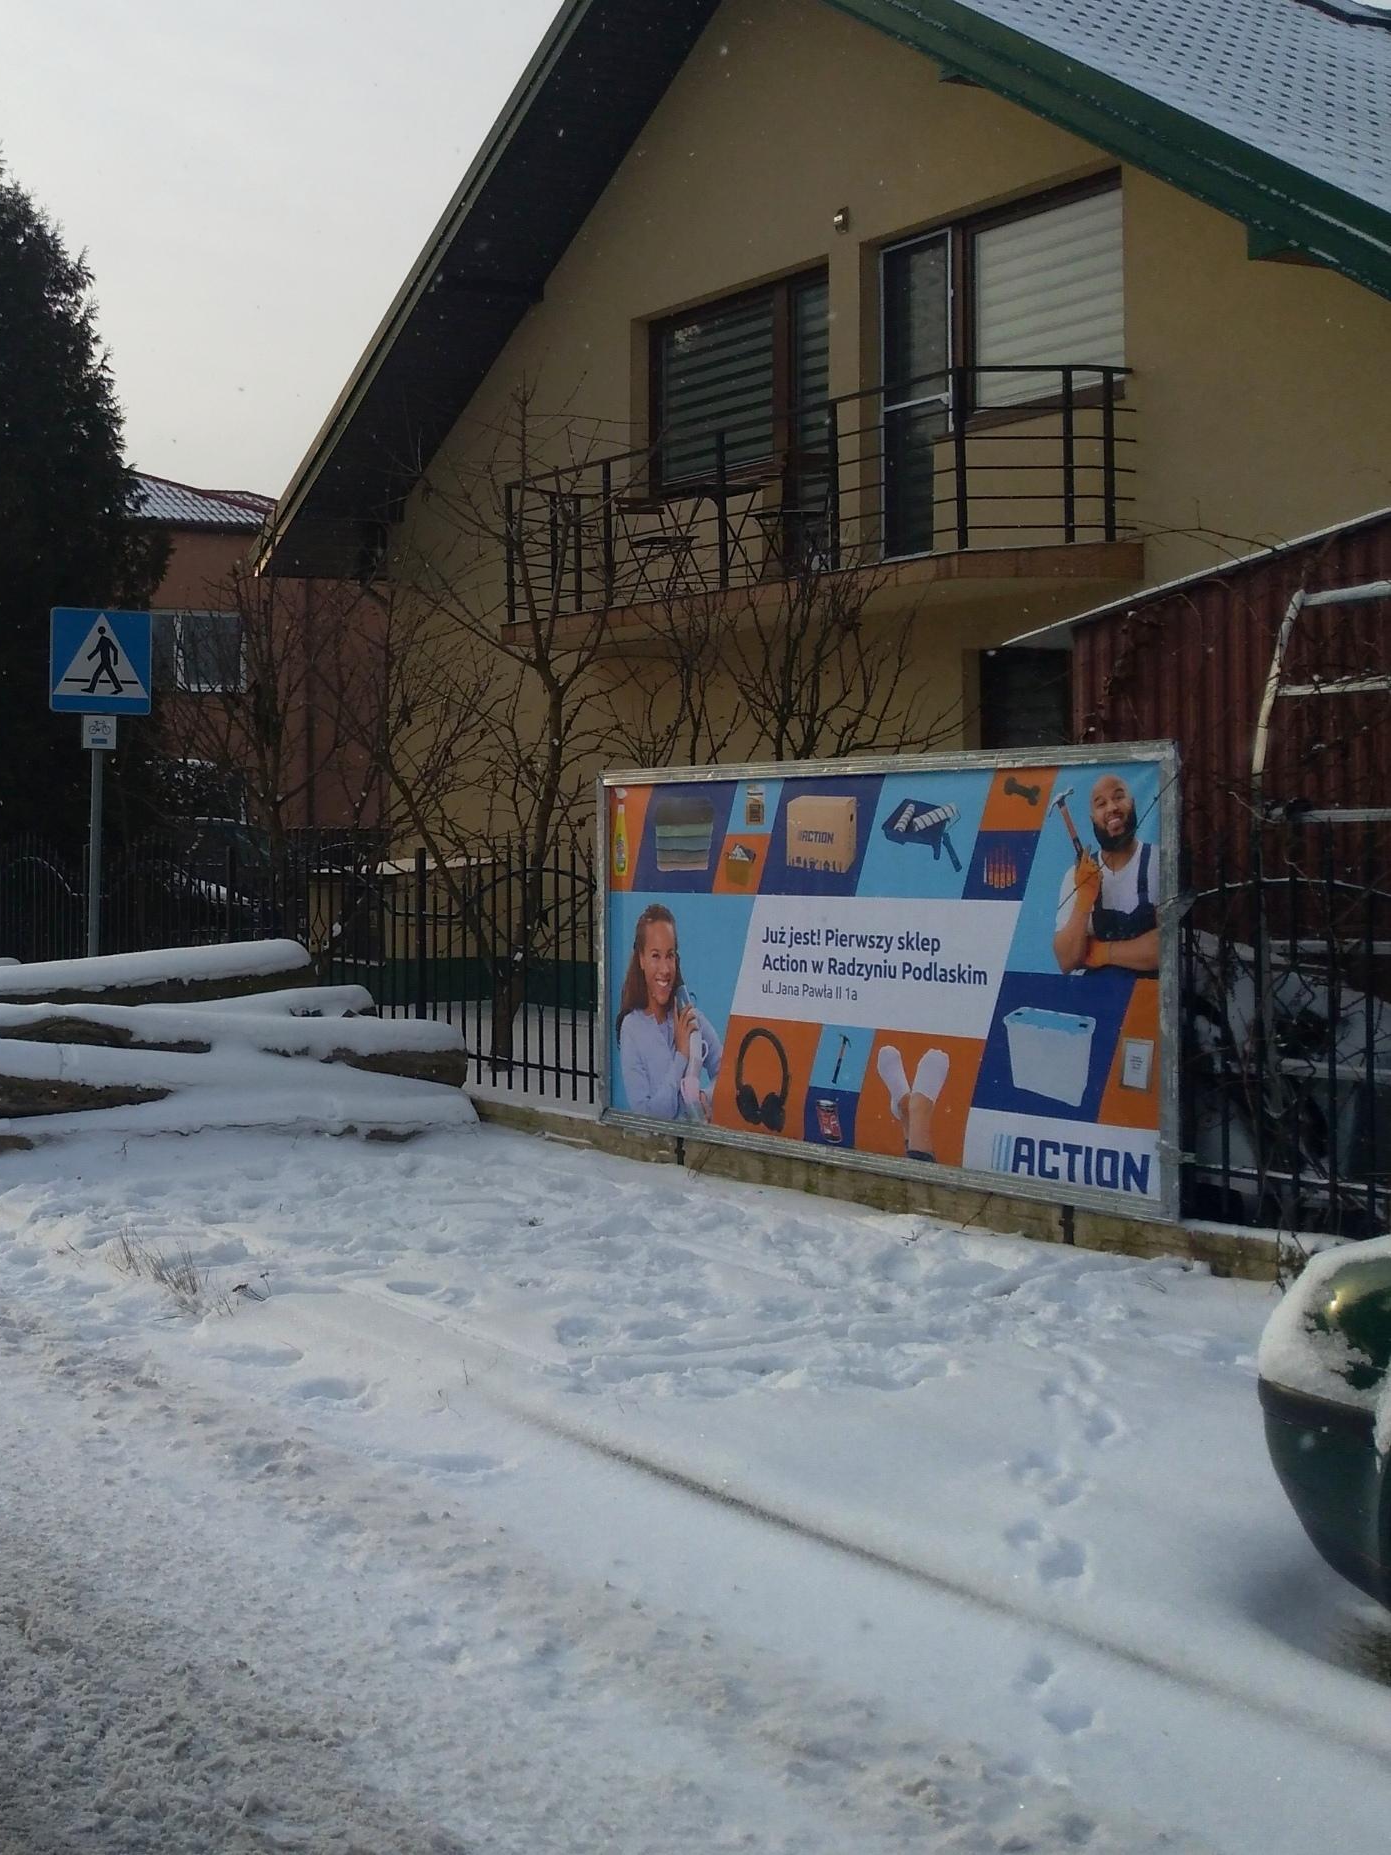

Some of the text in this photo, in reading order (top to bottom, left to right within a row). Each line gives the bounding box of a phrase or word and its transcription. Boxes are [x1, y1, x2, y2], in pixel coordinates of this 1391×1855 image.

[801, 830, 834, 844] ACTION
[762, 926, 941, 955] Już jest! Pierwszy sklep
[762, 954, 988, 985] Action w Radzyniu Podlaskim
[762, 980, 858, 1001] ul. Jana Pawła II 1a
[1011, 1136, 1151, 1194] ACTION
